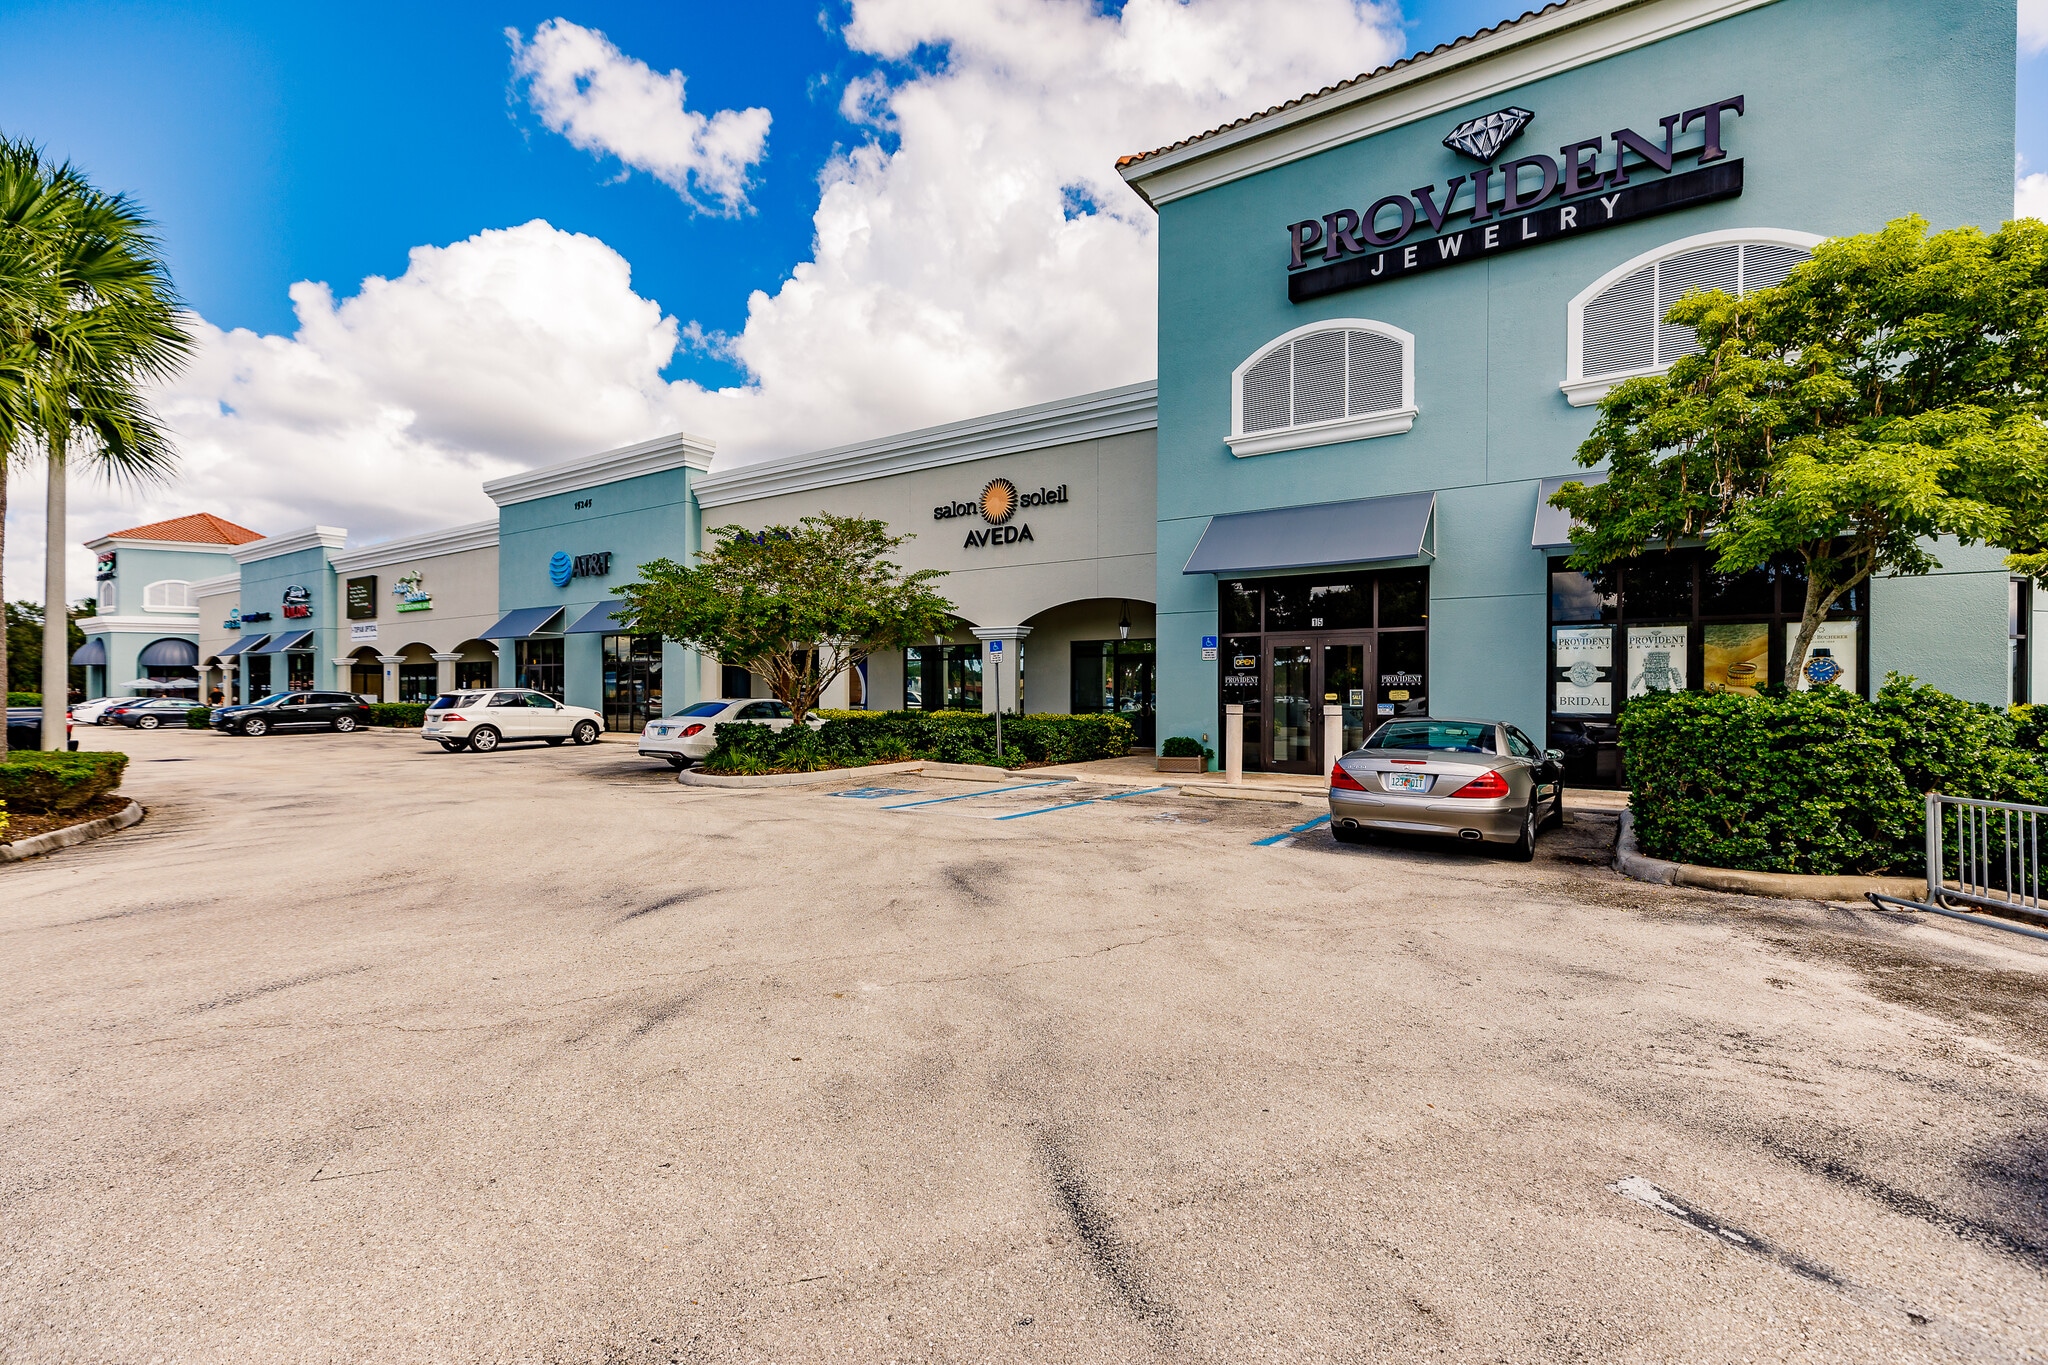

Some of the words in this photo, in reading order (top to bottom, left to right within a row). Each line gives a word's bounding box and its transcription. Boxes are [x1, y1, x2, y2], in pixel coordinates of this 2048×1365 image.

[1287, 95, 1744, 271] PROVIDENT
[1370, 193, 1622, 276] JEWELRY
[934, 501, 978, 520] salon
[1020, 484, 1069, 508] soleil
[963, 523, 1034, 549] AVEDA
[571, 551, 612, 578] AT&T
[1558, 637, 1611, 646] PROVIDENT
[1629, 635, 1686, 645] PROVIDENT
[1381, 674, 1422, 683] PROVIDENT
[1559, 696, 1610, 706] BRIDAL
[1391, 777, 1404, 787] 123
